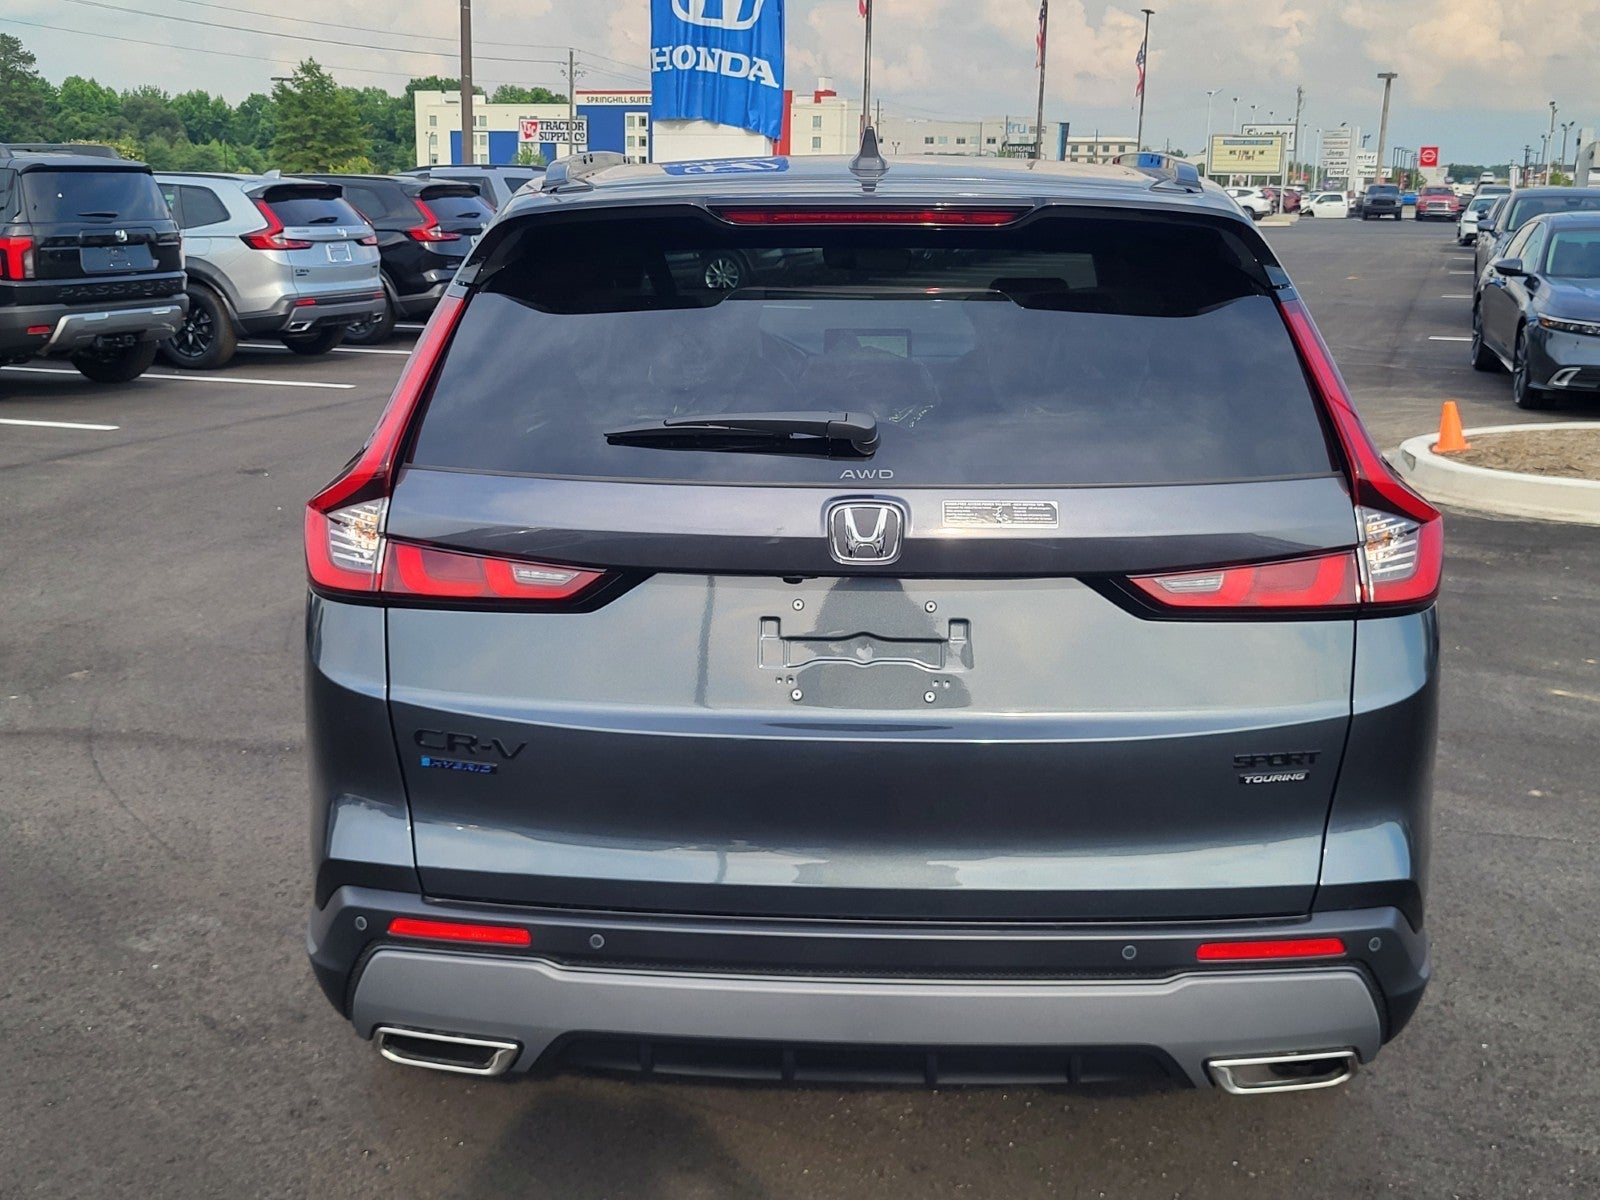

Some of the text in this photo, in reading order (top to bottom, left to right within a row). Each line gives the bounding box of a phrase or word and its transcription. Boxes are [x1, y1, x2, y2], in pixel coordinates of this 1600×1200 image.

[651, 44, 780, 88] HONDA
[586, 96, 627, 104] SPRINGHILL
[539, 120, 585, 131] TRACTOR
[56, 279, 180, 298] PASSPORT
[839, 469, 894, 480] AWD
[414, 728, 528, 760] CR-V
[1232, 750, 1322, 769] SPORT
[1244, 772, 1306, 784] TOURING
